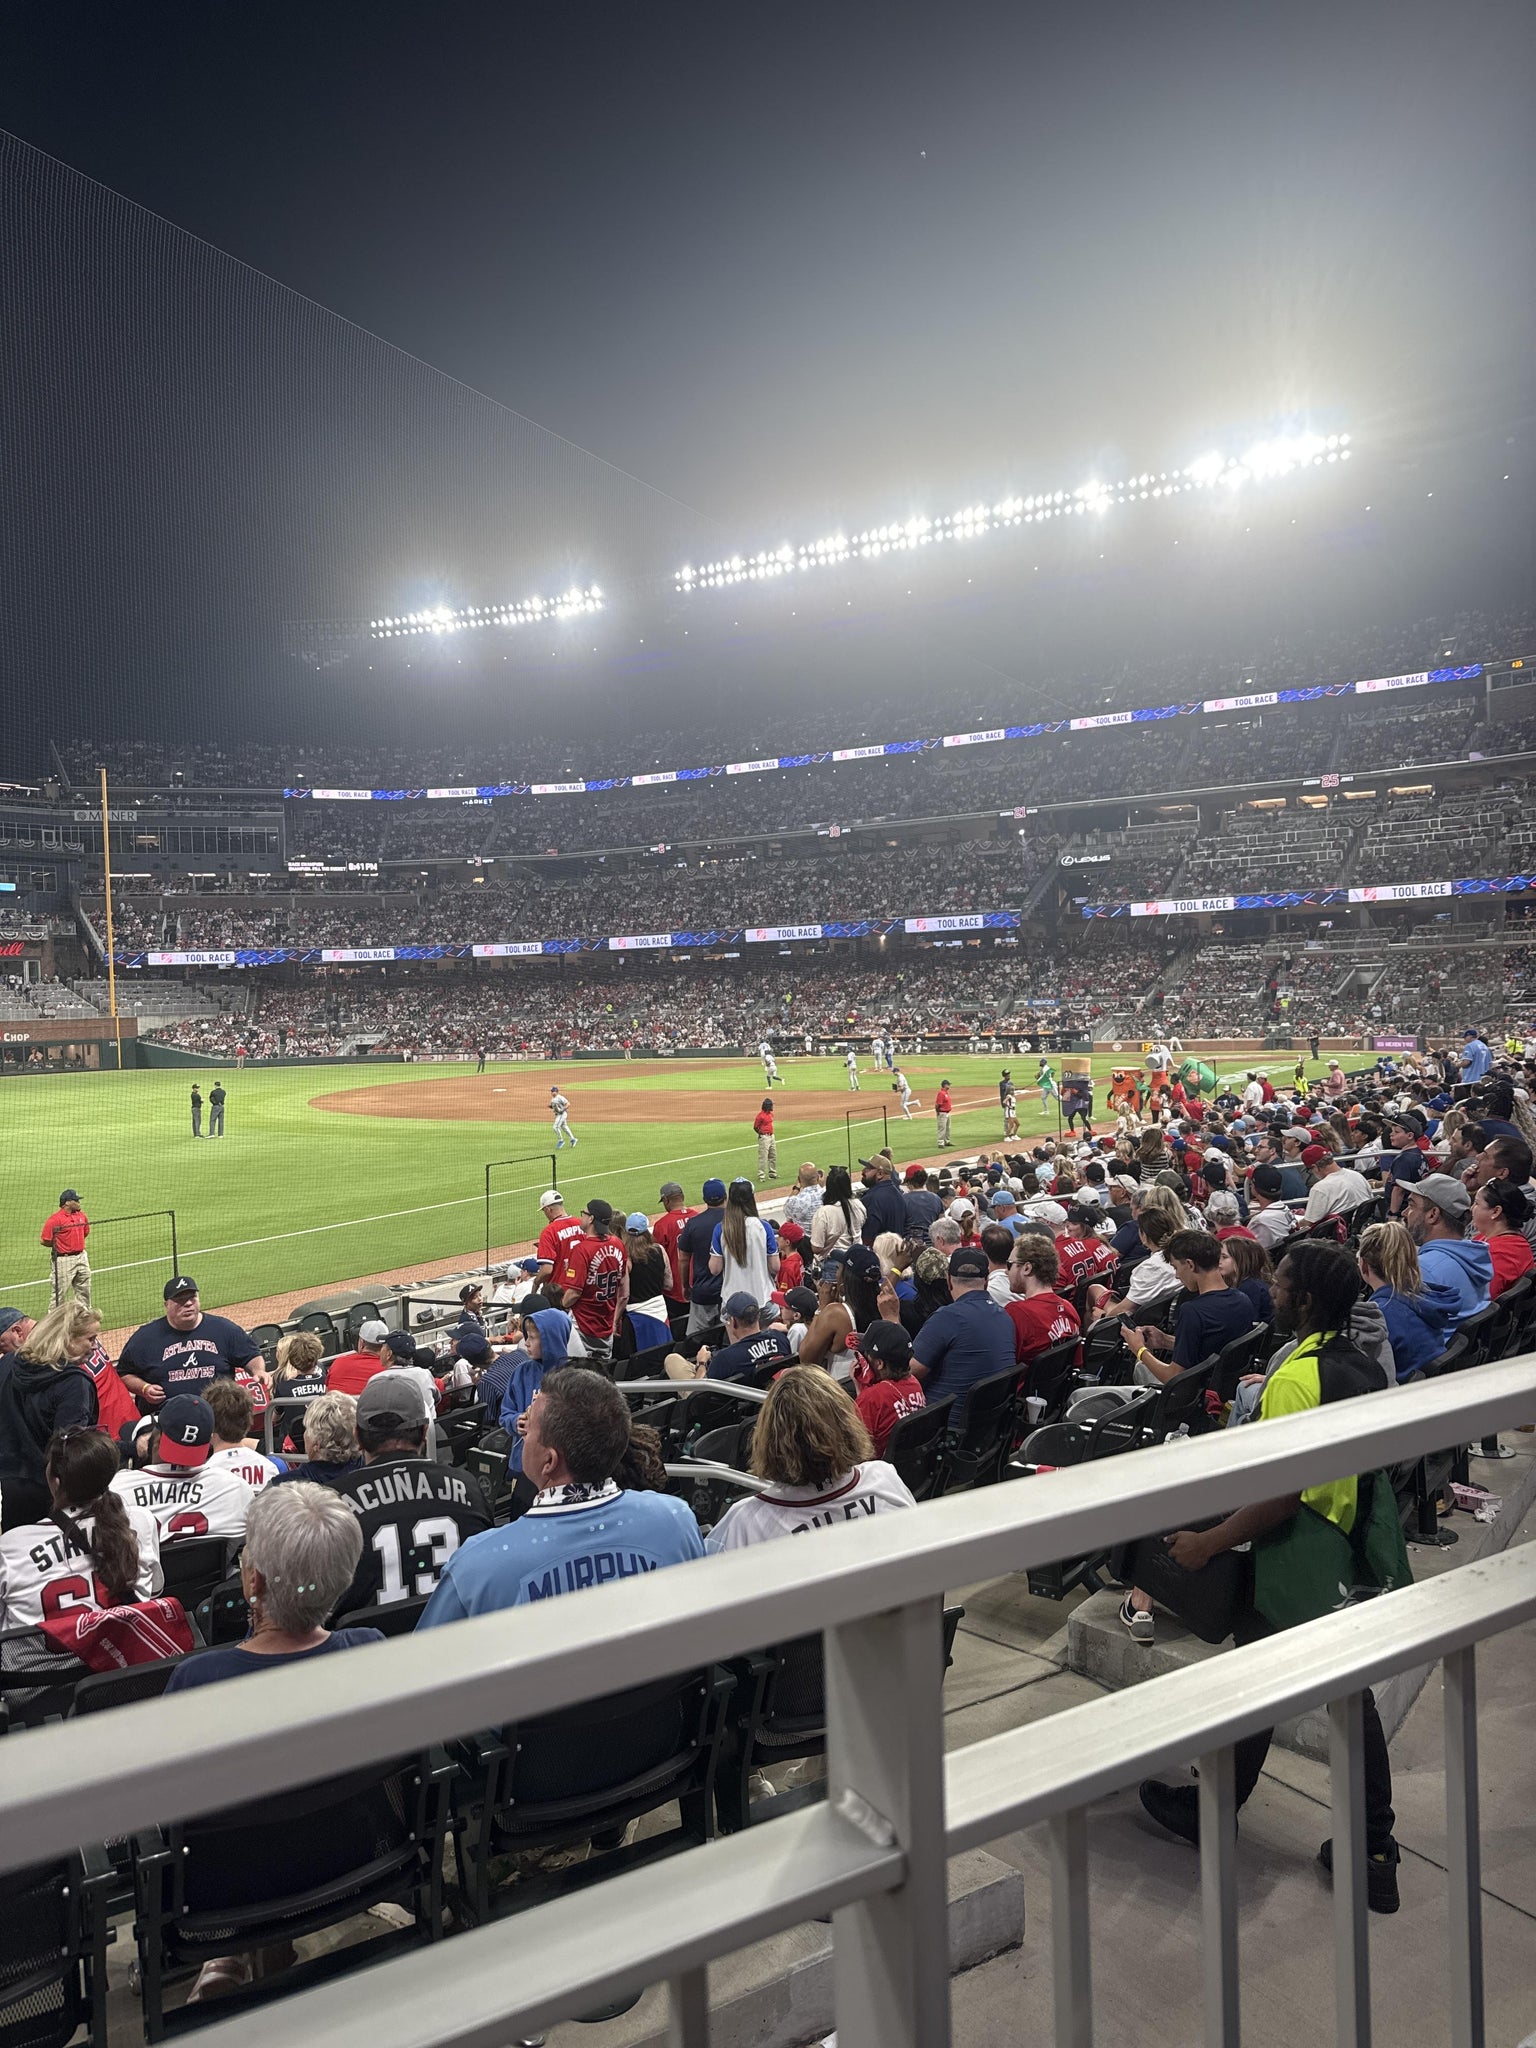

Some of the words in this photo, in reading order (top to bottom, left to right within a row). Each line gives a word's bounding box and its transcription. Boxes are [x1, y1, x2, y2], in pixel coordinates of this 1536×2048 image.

[1387, 679, 1404, 687] TOOL
[1406, 675, 1424, 685] RACE
[1235, 698, 1253, 706] TOOL
[1255, 696, 1273, 704] RACE
[1096, 716, 1110, 724] TOOL
[1113, 714, 1128, 722] RACE
[969, 734, 984, 742] TOOL
[986, 732, 1001, 740] RACE
[1322, 774, 1339, 788] 25
[90, 811, 134, 820] MNER
[1075, 855, 1110, 863] LEXUS
[1392, 886, 1418, 897] TOOL
[1420, 885, 1445, 896] RACE
[1174, 902, 1200, 912] TOOL
[1202, 899, 1228, 910] RACE
[938, 919, 956, 928] TOOL
[959, 918, 979, 927] RACE
[777, 929, 796, 938] TOOL
[798, 928, 818, 937] RACE
[635, 938, 650, 946] TOOL
[652, 937, 668, 945] RACE
[354, 951, 372, 959] TOOL
[374, 950, 391, 958] RACE
[505, 946, 521, 954] TOOL
[523, 944, 538, 953] RACE
[185, 954, 207, 962] TOOL
[209, 954, 230, 962] RACE
[4, 1033, 29, 1041] CHOP
[557, 1224, 586, 1241] MURPH
[596, 1270, 618, 1301] 56
[162, 1340, 218, 1360] ATLANTA
[748, 1339, 778, 1362] JONES
[168, 1366, 215, 1382] BRAVES
[181, 1425, 199, 1442] B
[341, 1467, 434, 1515] ACUÑA
[438, 1476, 471, 1507] JR.
[372, 1516, 460, 1605] 13
